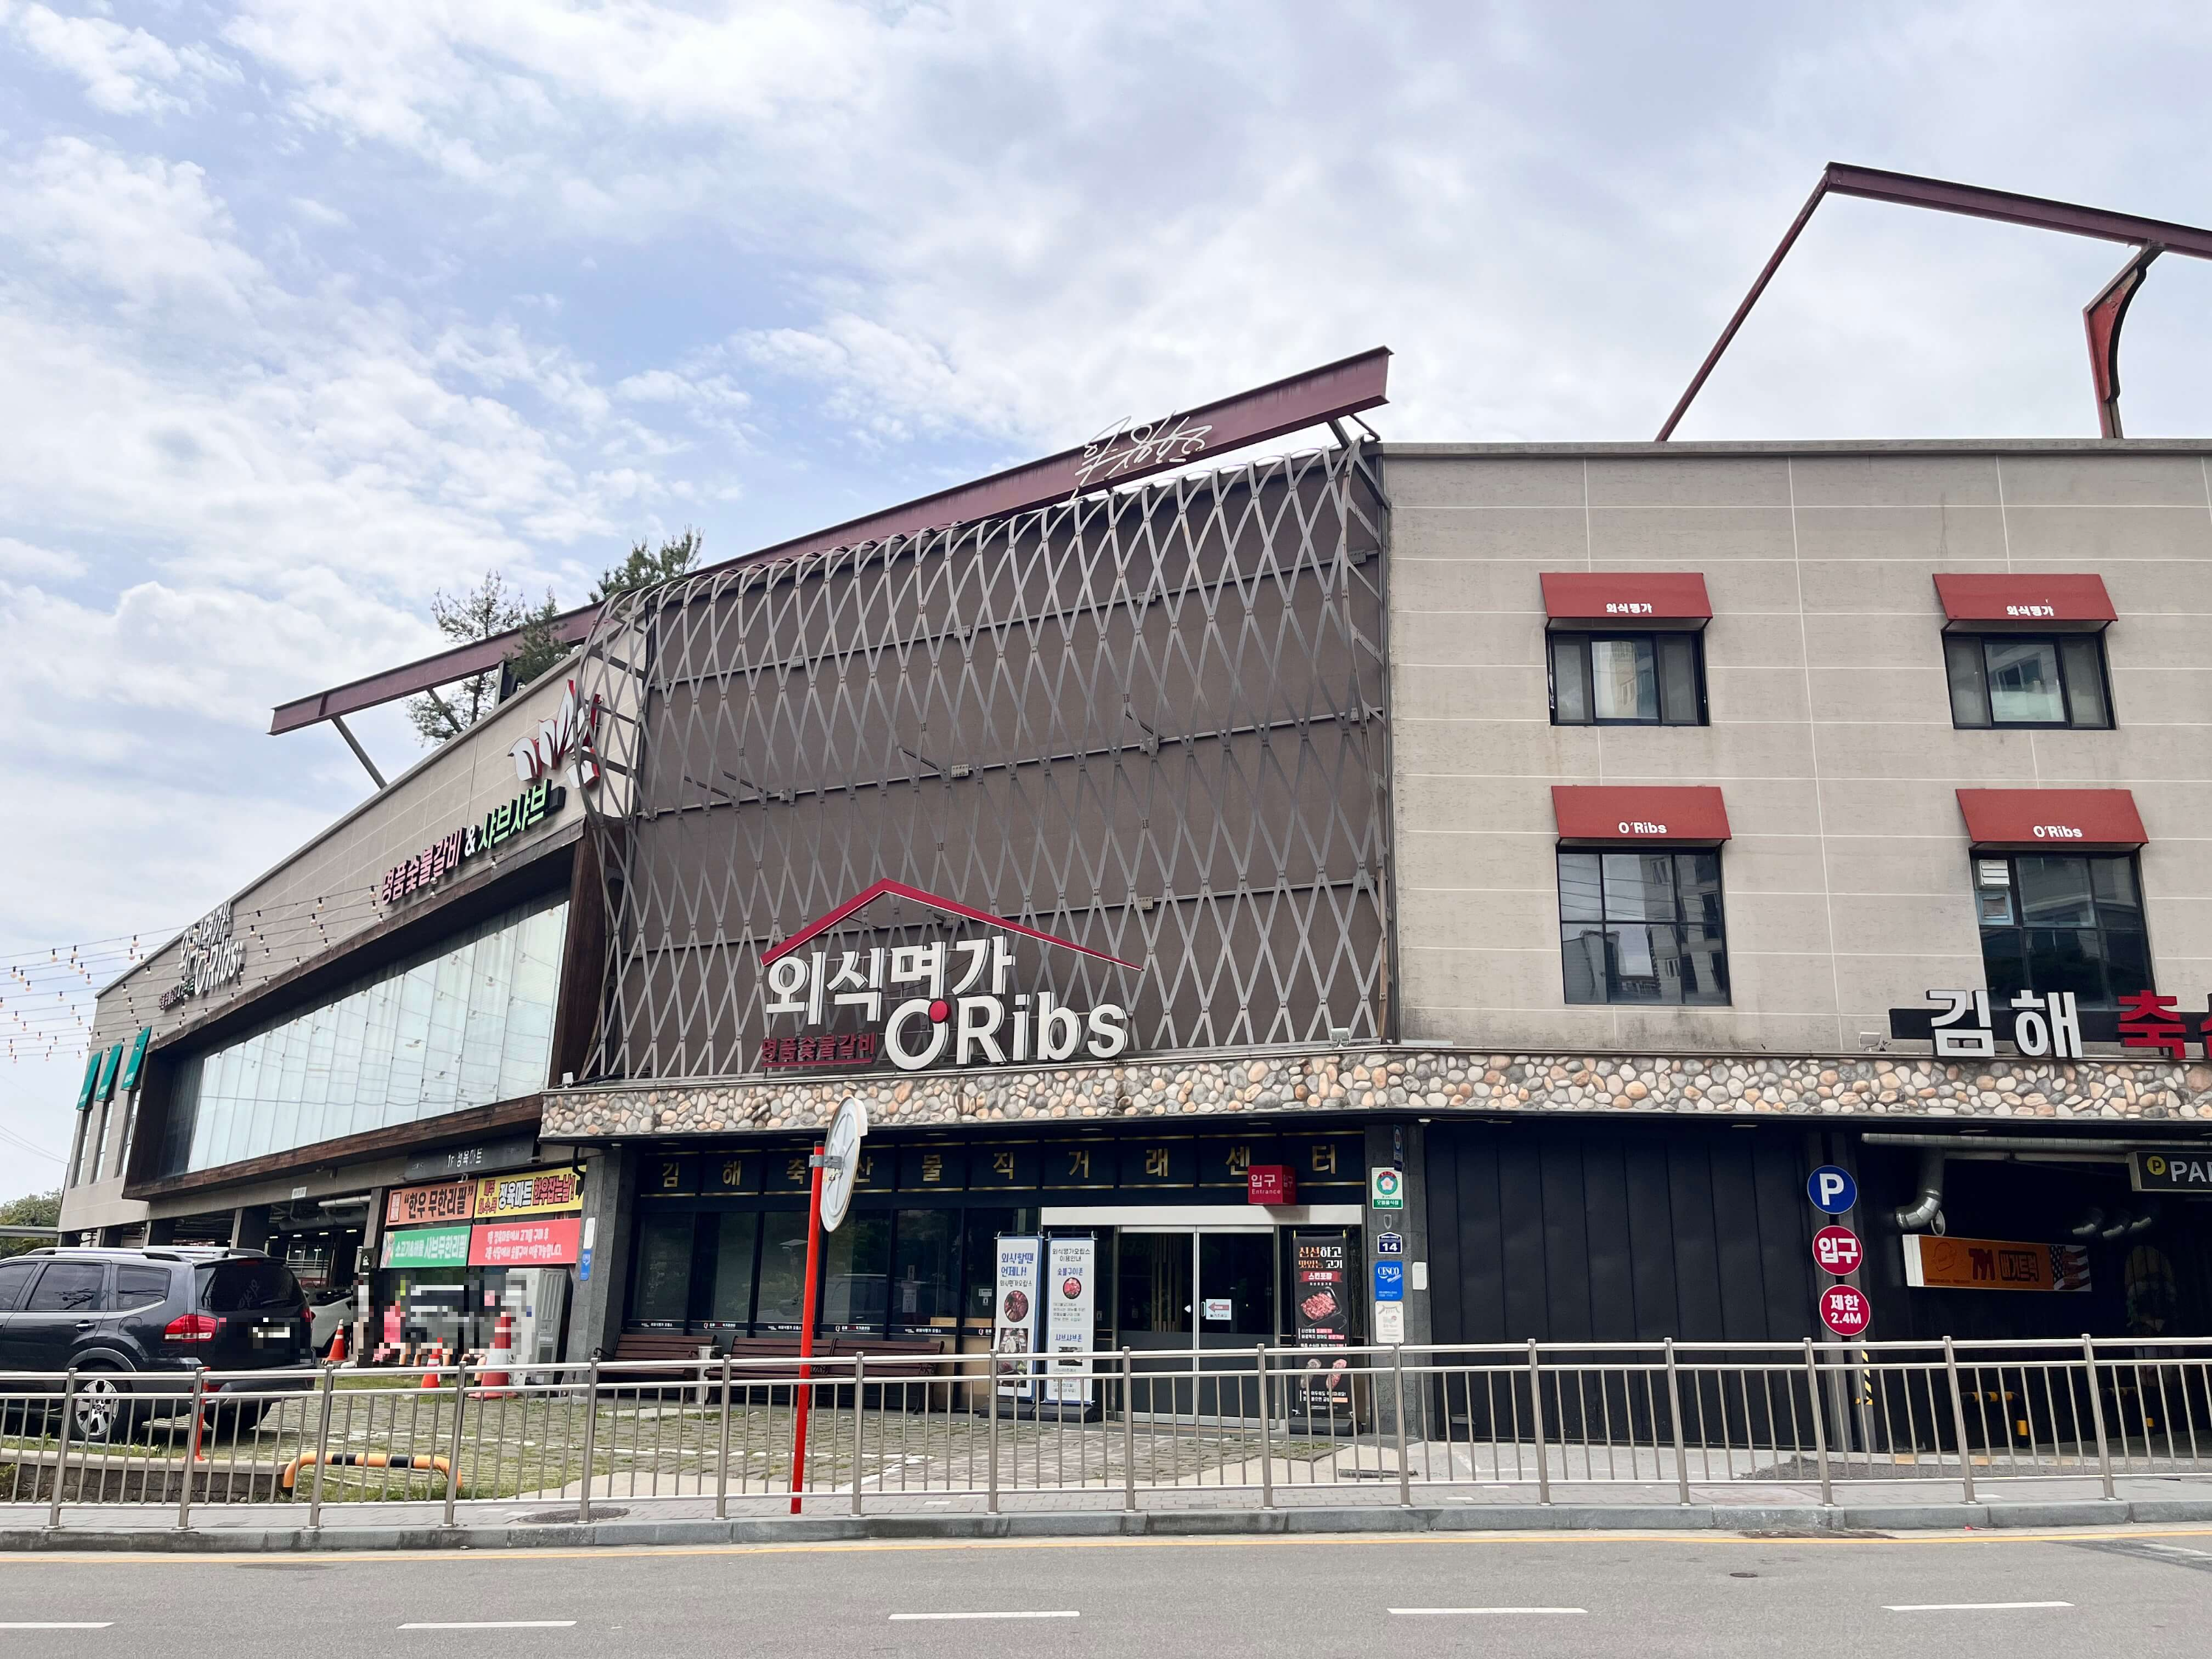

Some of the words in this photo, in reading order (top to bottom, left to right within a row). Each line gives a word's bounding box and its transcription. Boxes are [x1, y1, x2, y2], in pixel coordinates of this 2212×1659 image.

[1607, 603, 1652, 613] 외식명가
[2006, 605, 2054, 616] 외식명가
[1618, 821, 1667, 834] O'Ribs
[2033, 826, 2083, 838] O'Ribs
[382, 827, 466, 905] 명품숯불갈비
[465, 824, 479, 858] &
[478, 779, 552, 852] 샤브샤브
[762, 1032, 876, 1061] 명품숯불갈비
[1251, 1174, 1276, 1188] 입구
[498, 1179, 533, 1209] 정육마트
[1819, 1173, 1844, 1206] P
[1299, 1246, 1342, 1257] 신선하고
[1382, 1242, 1398, 1251] 14
[1818, 1237, 1858, 1264] 입구
[1298, 1259, 1324, 1268] 맛있는
[1326, 1259, 1343, 1268] 고기
[1001, 1266, 1026, 1277] 언제나!
[1377, 1267, 1399, 1276] CESCO
[1829, 1294, 1859, 1311] 제한
[1830, 1312, 1861, 1324] 2.4M
